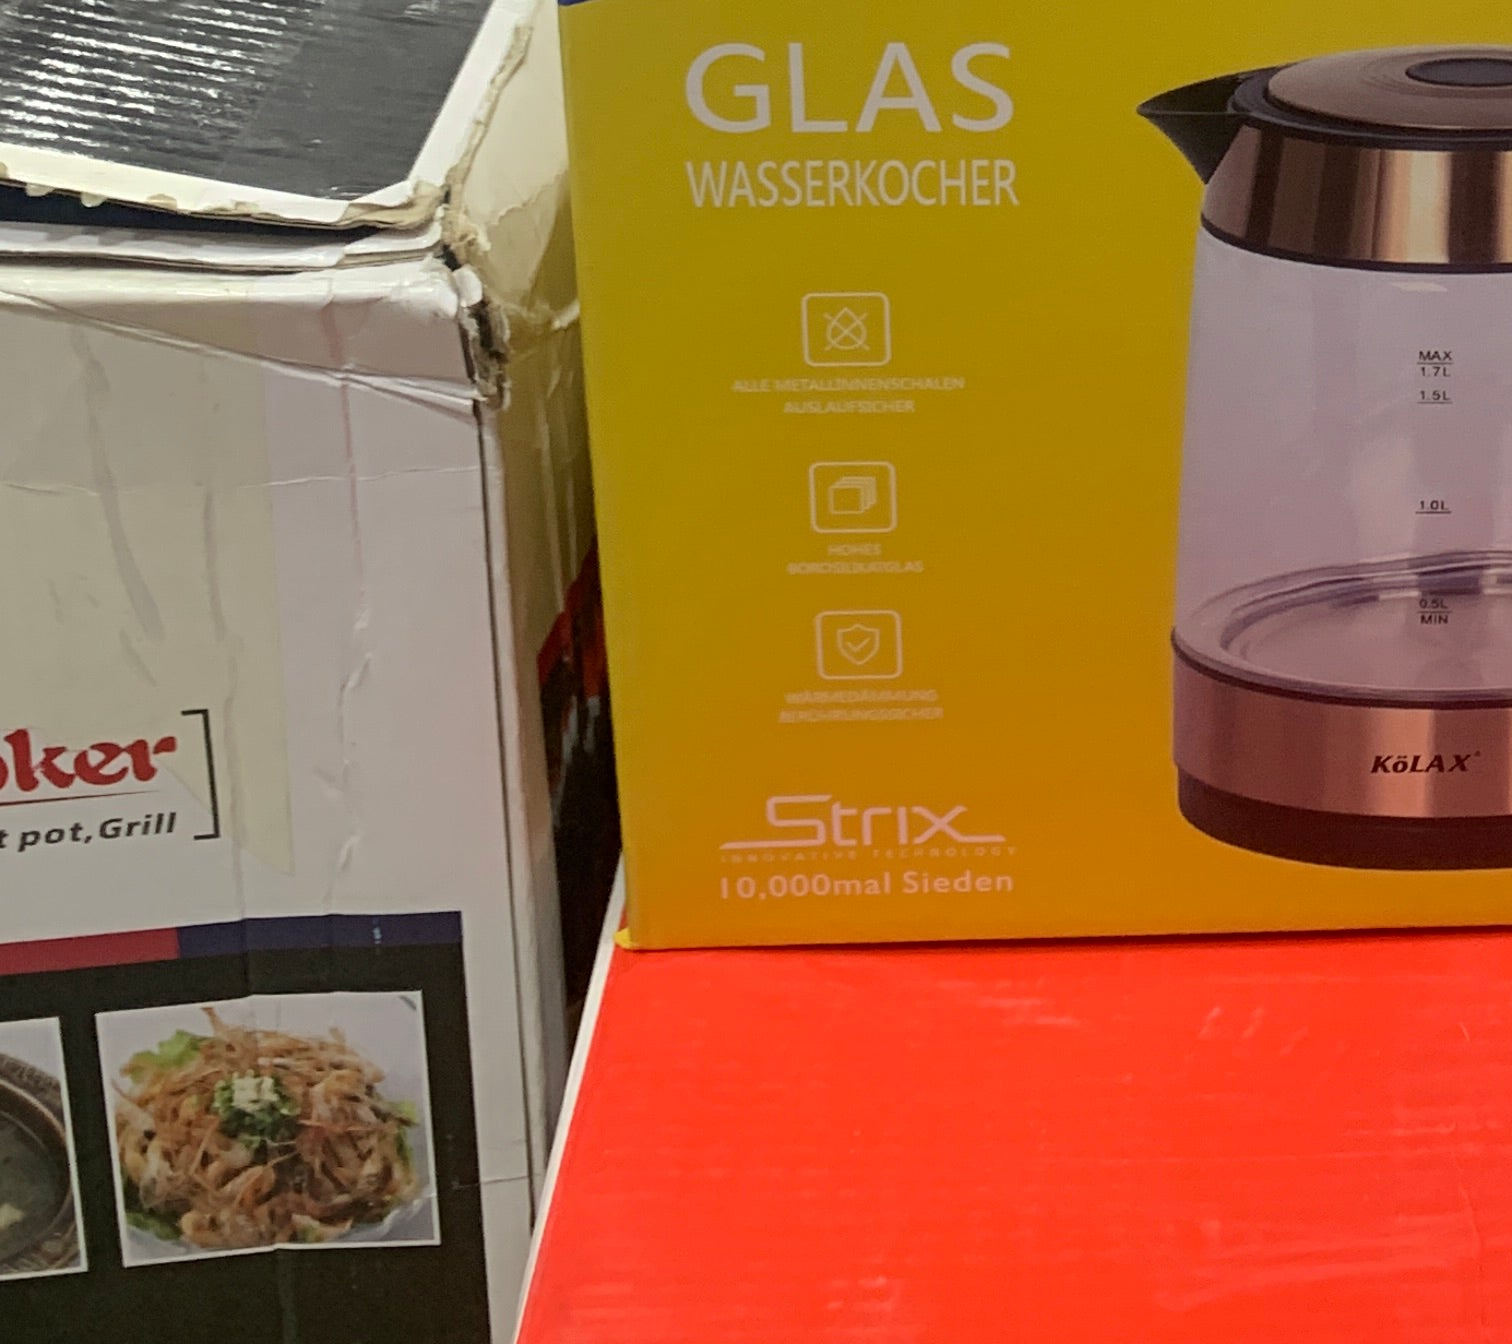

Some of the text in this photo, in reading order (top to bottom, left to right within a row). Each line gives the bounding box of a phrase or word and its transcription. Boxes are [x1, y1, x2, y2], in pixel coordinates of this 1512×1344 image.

[684, 41, 1015, 134] GLAS
[685, 159, 1020, 209] WASSERKOCHER
[1418, 350, 1453, 361] MAX
[1420, 366, 1451, 377] 1.7L
[1419, 389, 1451, 401] 1.5L
[1419, 500, 1450, 511] 1.0L
[1419, 598, 1449, 609] 0.5L
[1419, 613, 1450, 625] MIN
[0, 728, 177, 792] ker
[720, 794, 1006, 850] Strix
[872, 846, 1017, 860] TECHNOLOGY
[720, 869, 1014, 900] 10,000mal Sieden
